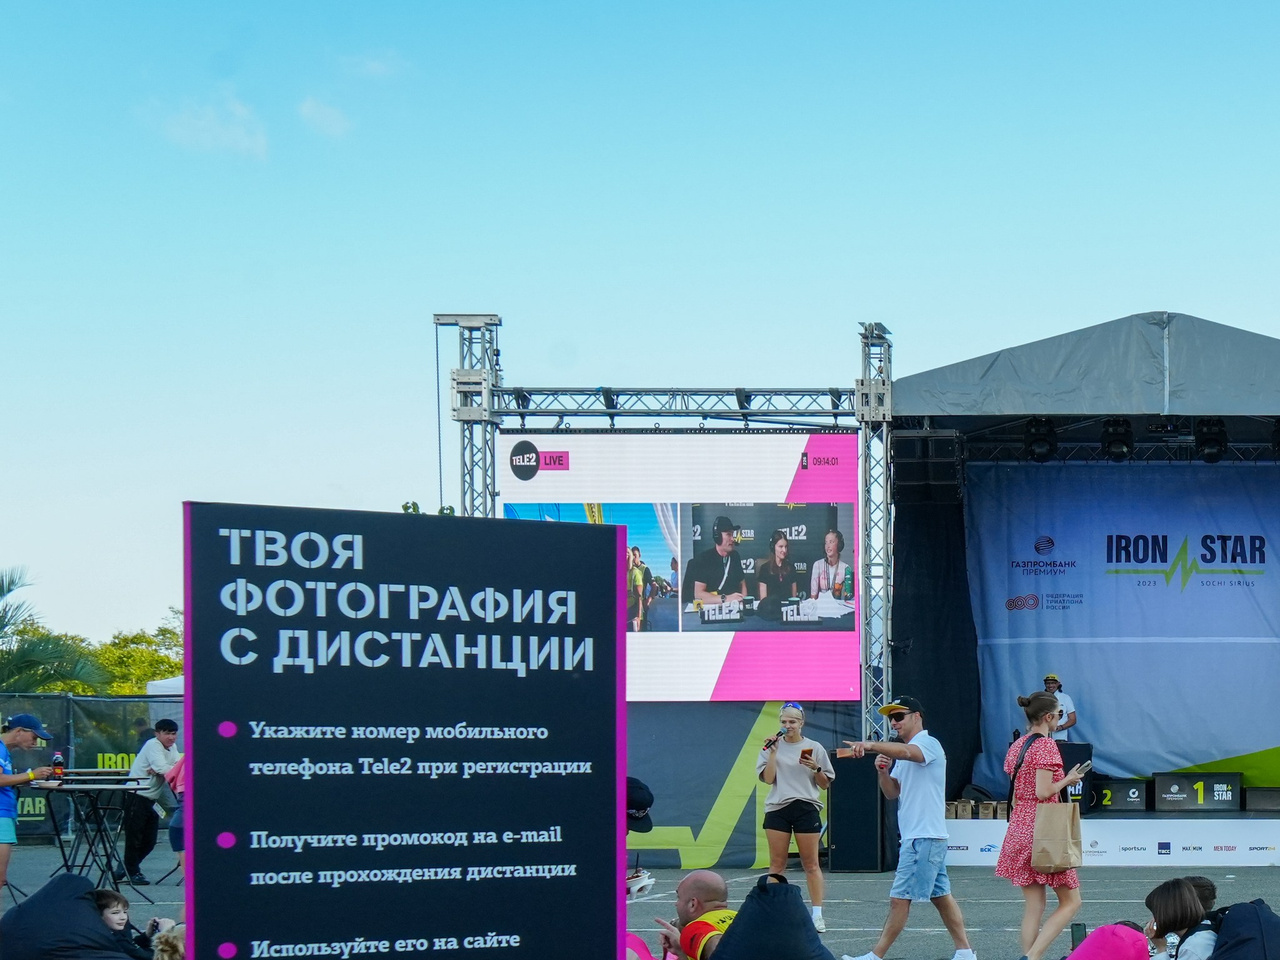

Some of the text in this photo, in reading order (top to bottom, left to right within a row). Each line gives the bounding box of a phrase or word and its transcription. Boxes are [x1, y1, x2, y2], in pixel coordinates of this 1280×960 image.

[512, 453, 564, 467] TELE2 LIVE
[812, 457, 839, 466] 09:14:01
[741, 530, 755, 539] STAR
[218, 529, 364, 569] ТВОЯ
[1106, 535, 1266, 564] IRON STAR
[1011, 560, 1077, 568] ГАЗПРОМБАНК
[1022, 568, 1066, 576] ПРЕМИУМ
[219, 578, 577, 625] ФОТОГРАФИЯ
[703, 602, 740, 621] TELE2
[219, 627, 594, 677] С ДИСТАНЦИИ
[249, 721, 549, 743] Укажите номер мобильного
[249, 757, 592, 779] телефона Tele2 при регистрации
[1102, 789, 1112, 805] 2
[1193, 781, 1204, 804] 1
[1213, 791, 1232, 800] STAR
[18, 797, 46, 815] TAR
[250, 826, 563, 852] Получите промокод на e-mail
[1121, 845, 1147, 853] sports.ru
[250, 862, 577, 888] после прохождения дистанции
[250, 932, 521, 959] Используйте его на сайте
